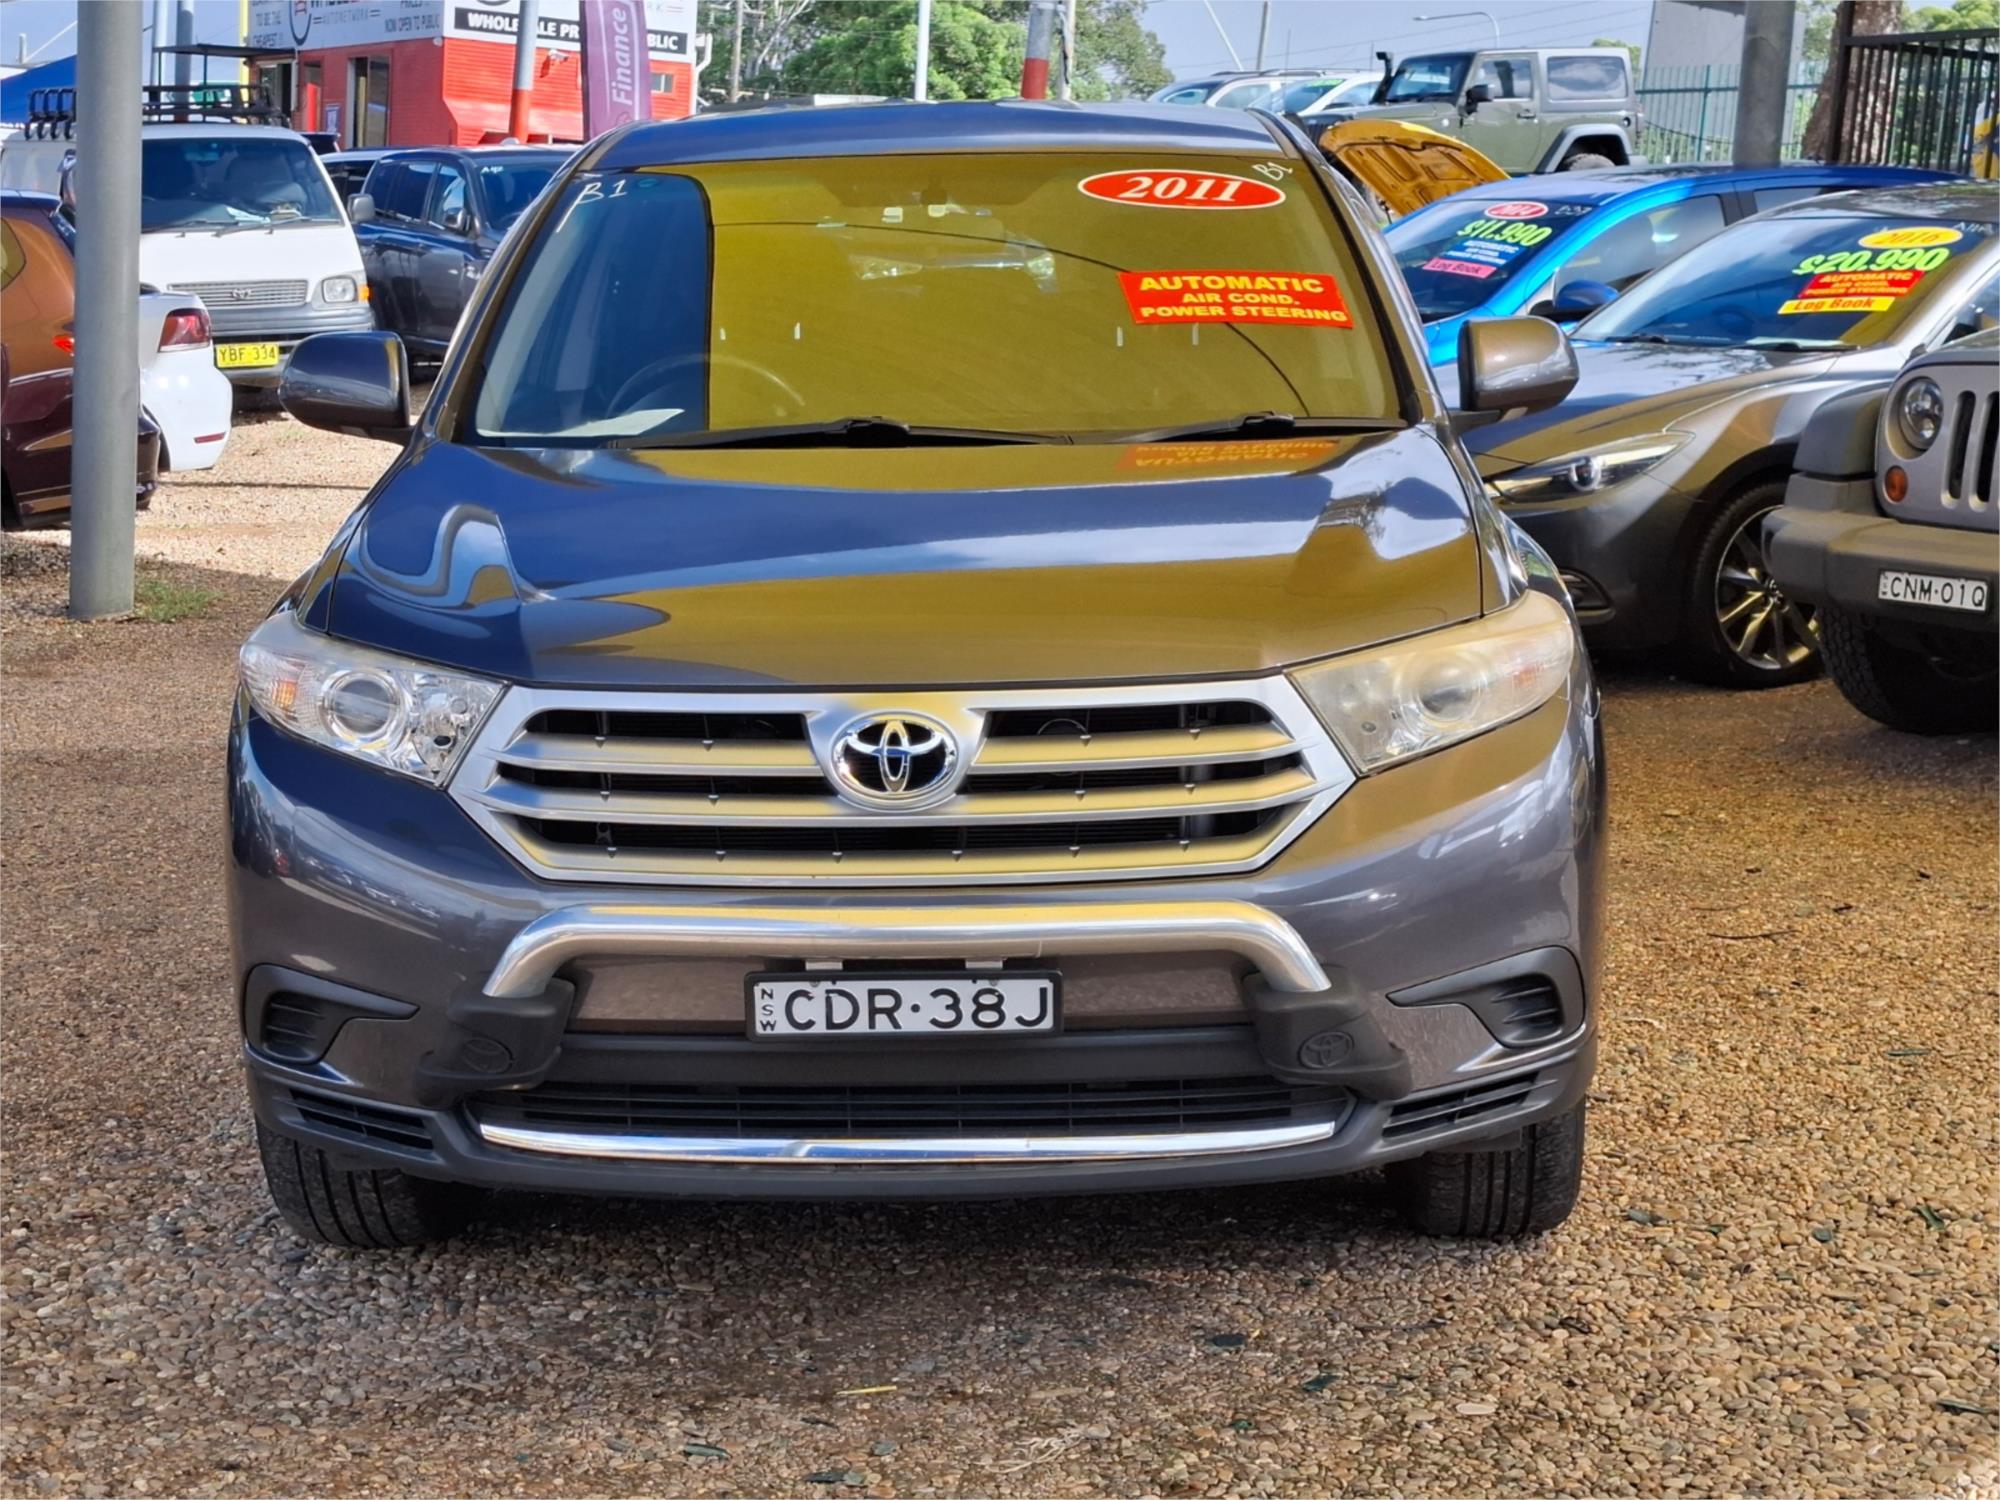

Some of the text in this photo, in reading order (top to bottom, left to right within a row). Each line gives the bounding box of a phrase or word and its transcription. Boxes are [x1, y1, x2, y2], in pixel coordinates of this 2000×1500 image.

[646, 33, 679, 50] BLIC
[611, 7, 633, 106] Finance
[1118, 175, 1243, 202] 2011
[1140, 275, 1324, 293] AUTOMATIC
[1819, 272, 1913, 284] AUTOMATIC
[1183, 293, 1301, 306] AIR COND.
[1793, 297, 1875, 314] Log Book
[1140, 306, 1348, 322] POWER STEERING
[219, 346, 249, 363] YBF
[760, 988, 778, 1032] NSW
